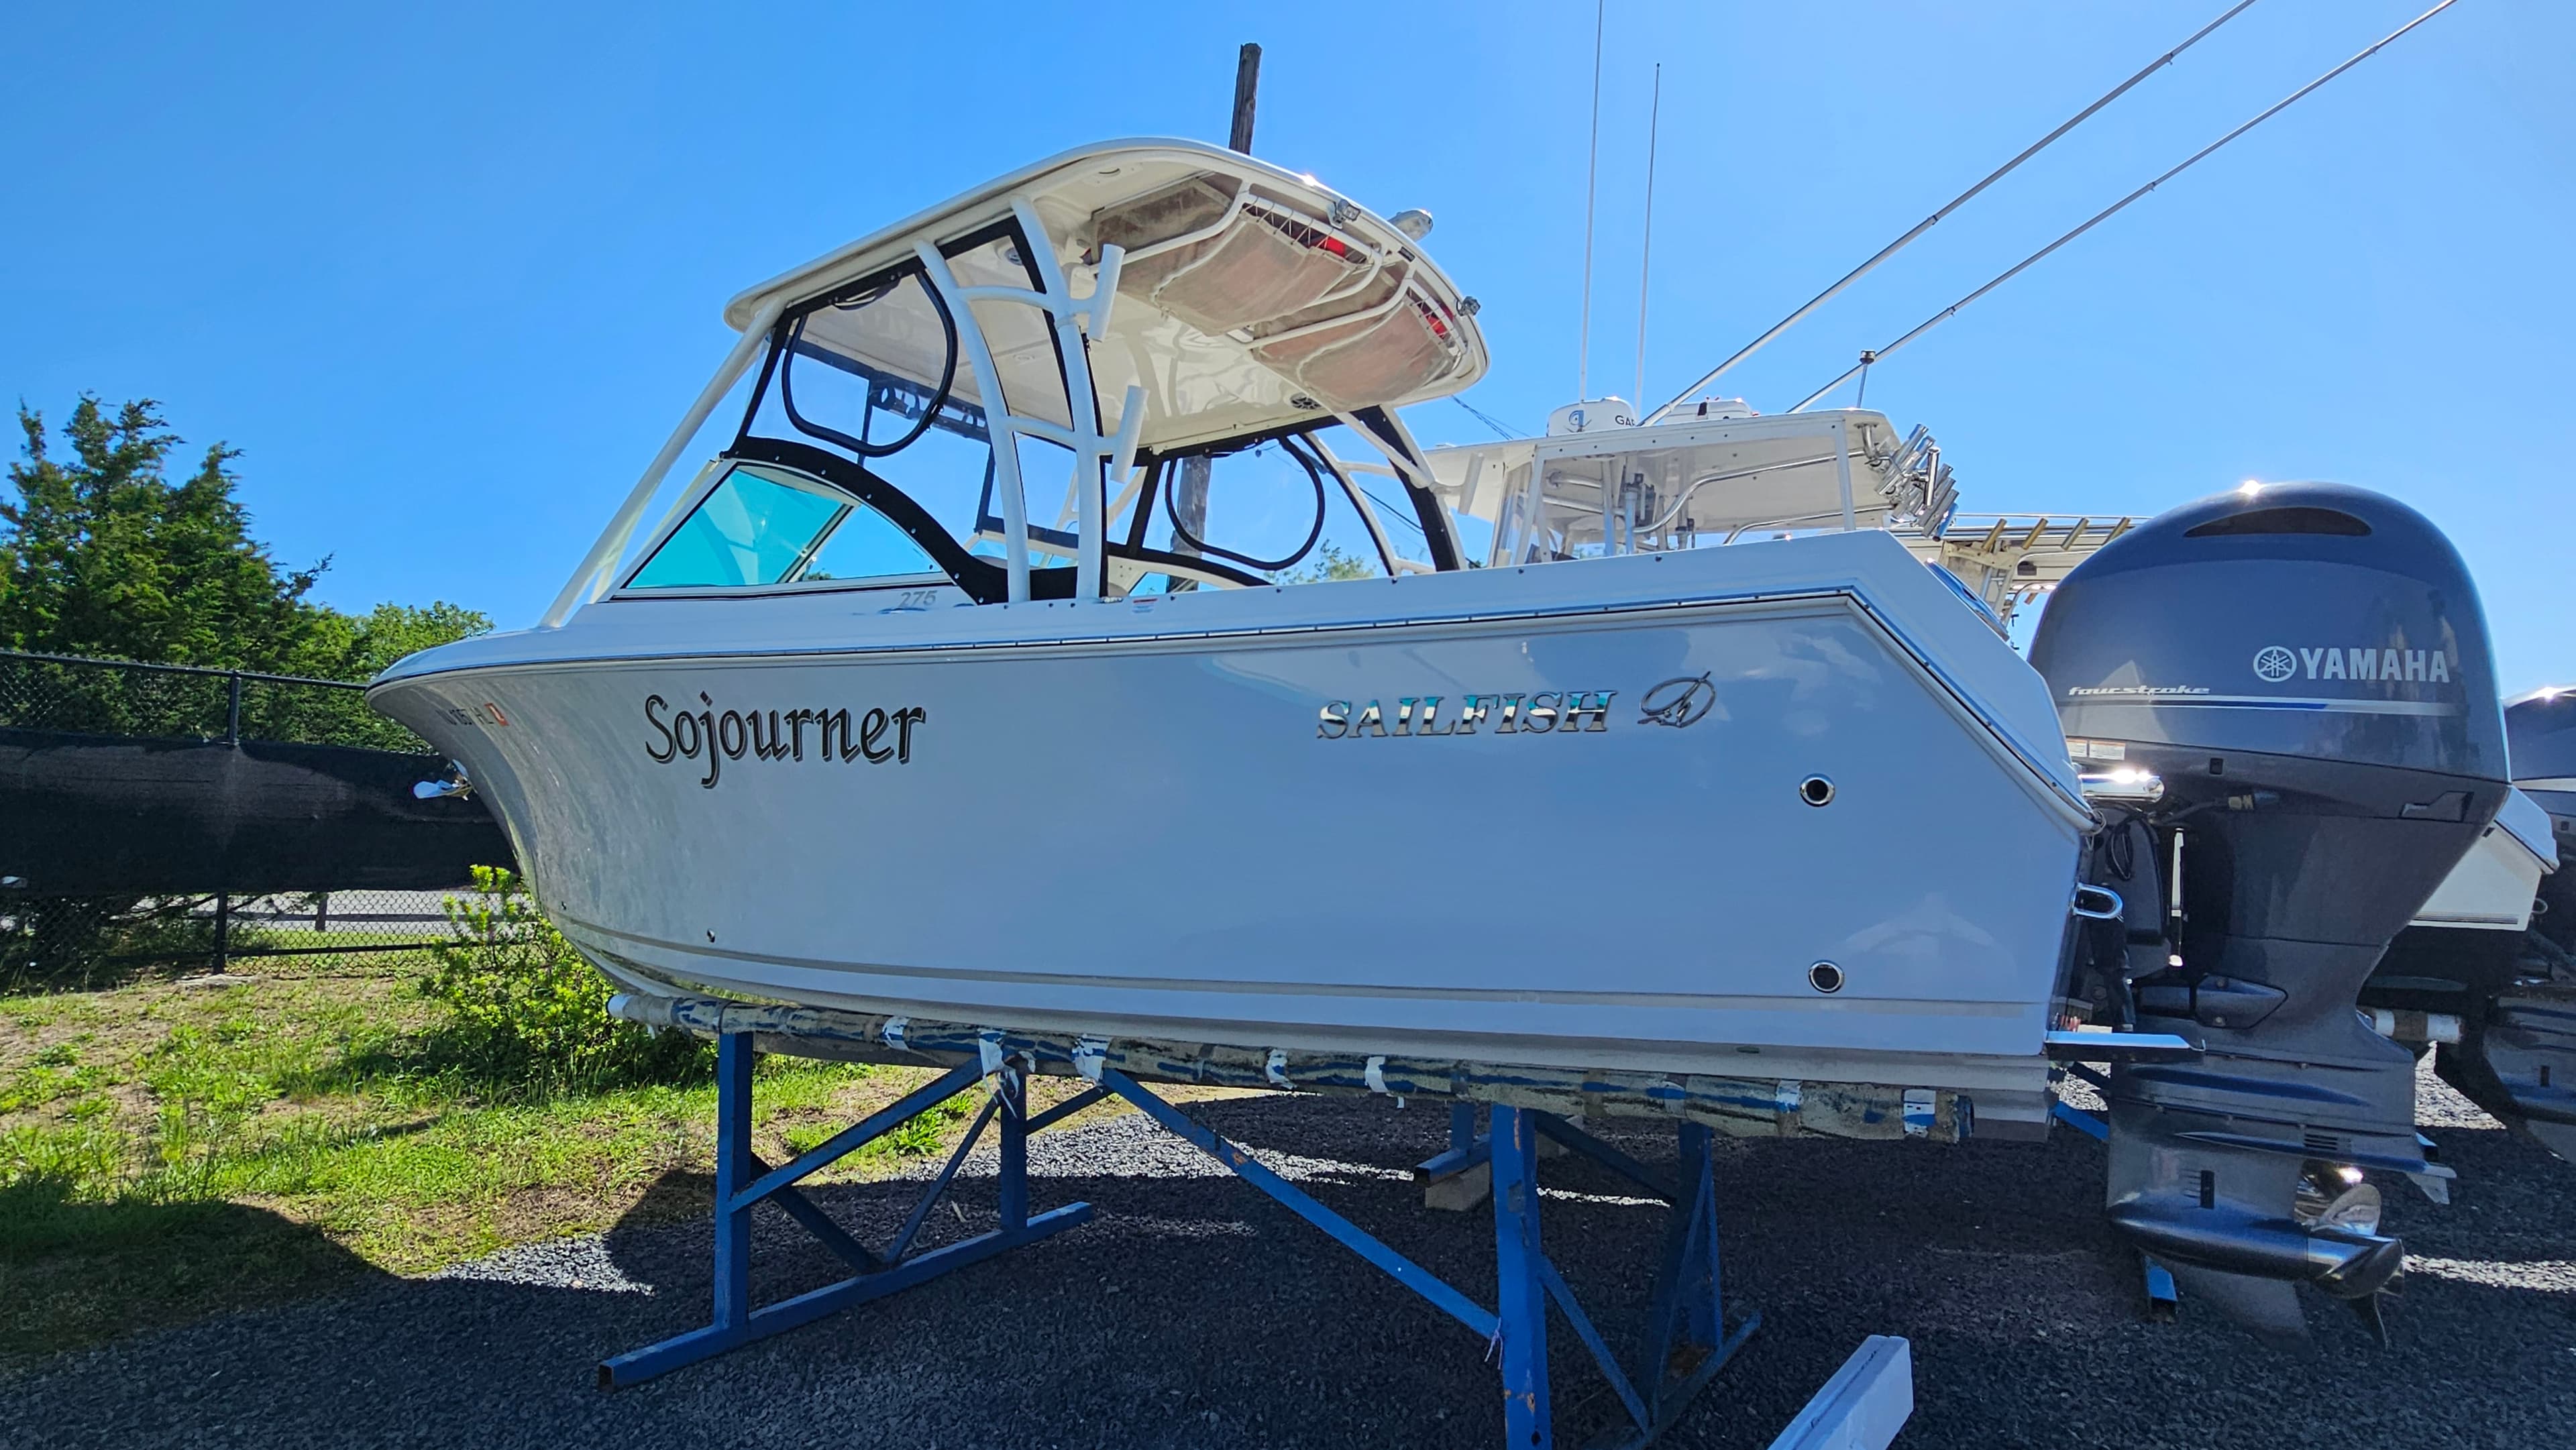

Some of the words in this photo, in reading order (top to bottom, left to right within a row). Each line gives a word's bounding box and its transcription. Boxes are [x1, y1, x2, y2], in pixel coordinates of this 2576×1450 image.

[899, 590, 938, 608] 275
[2299, 648, 2451, 683] YAMAHA
[2068, 685, 2210, 696] fourstroke
[1316, 689, 1618, 739] SAILFISH
[645, 691, 926, 790] Sojourner
